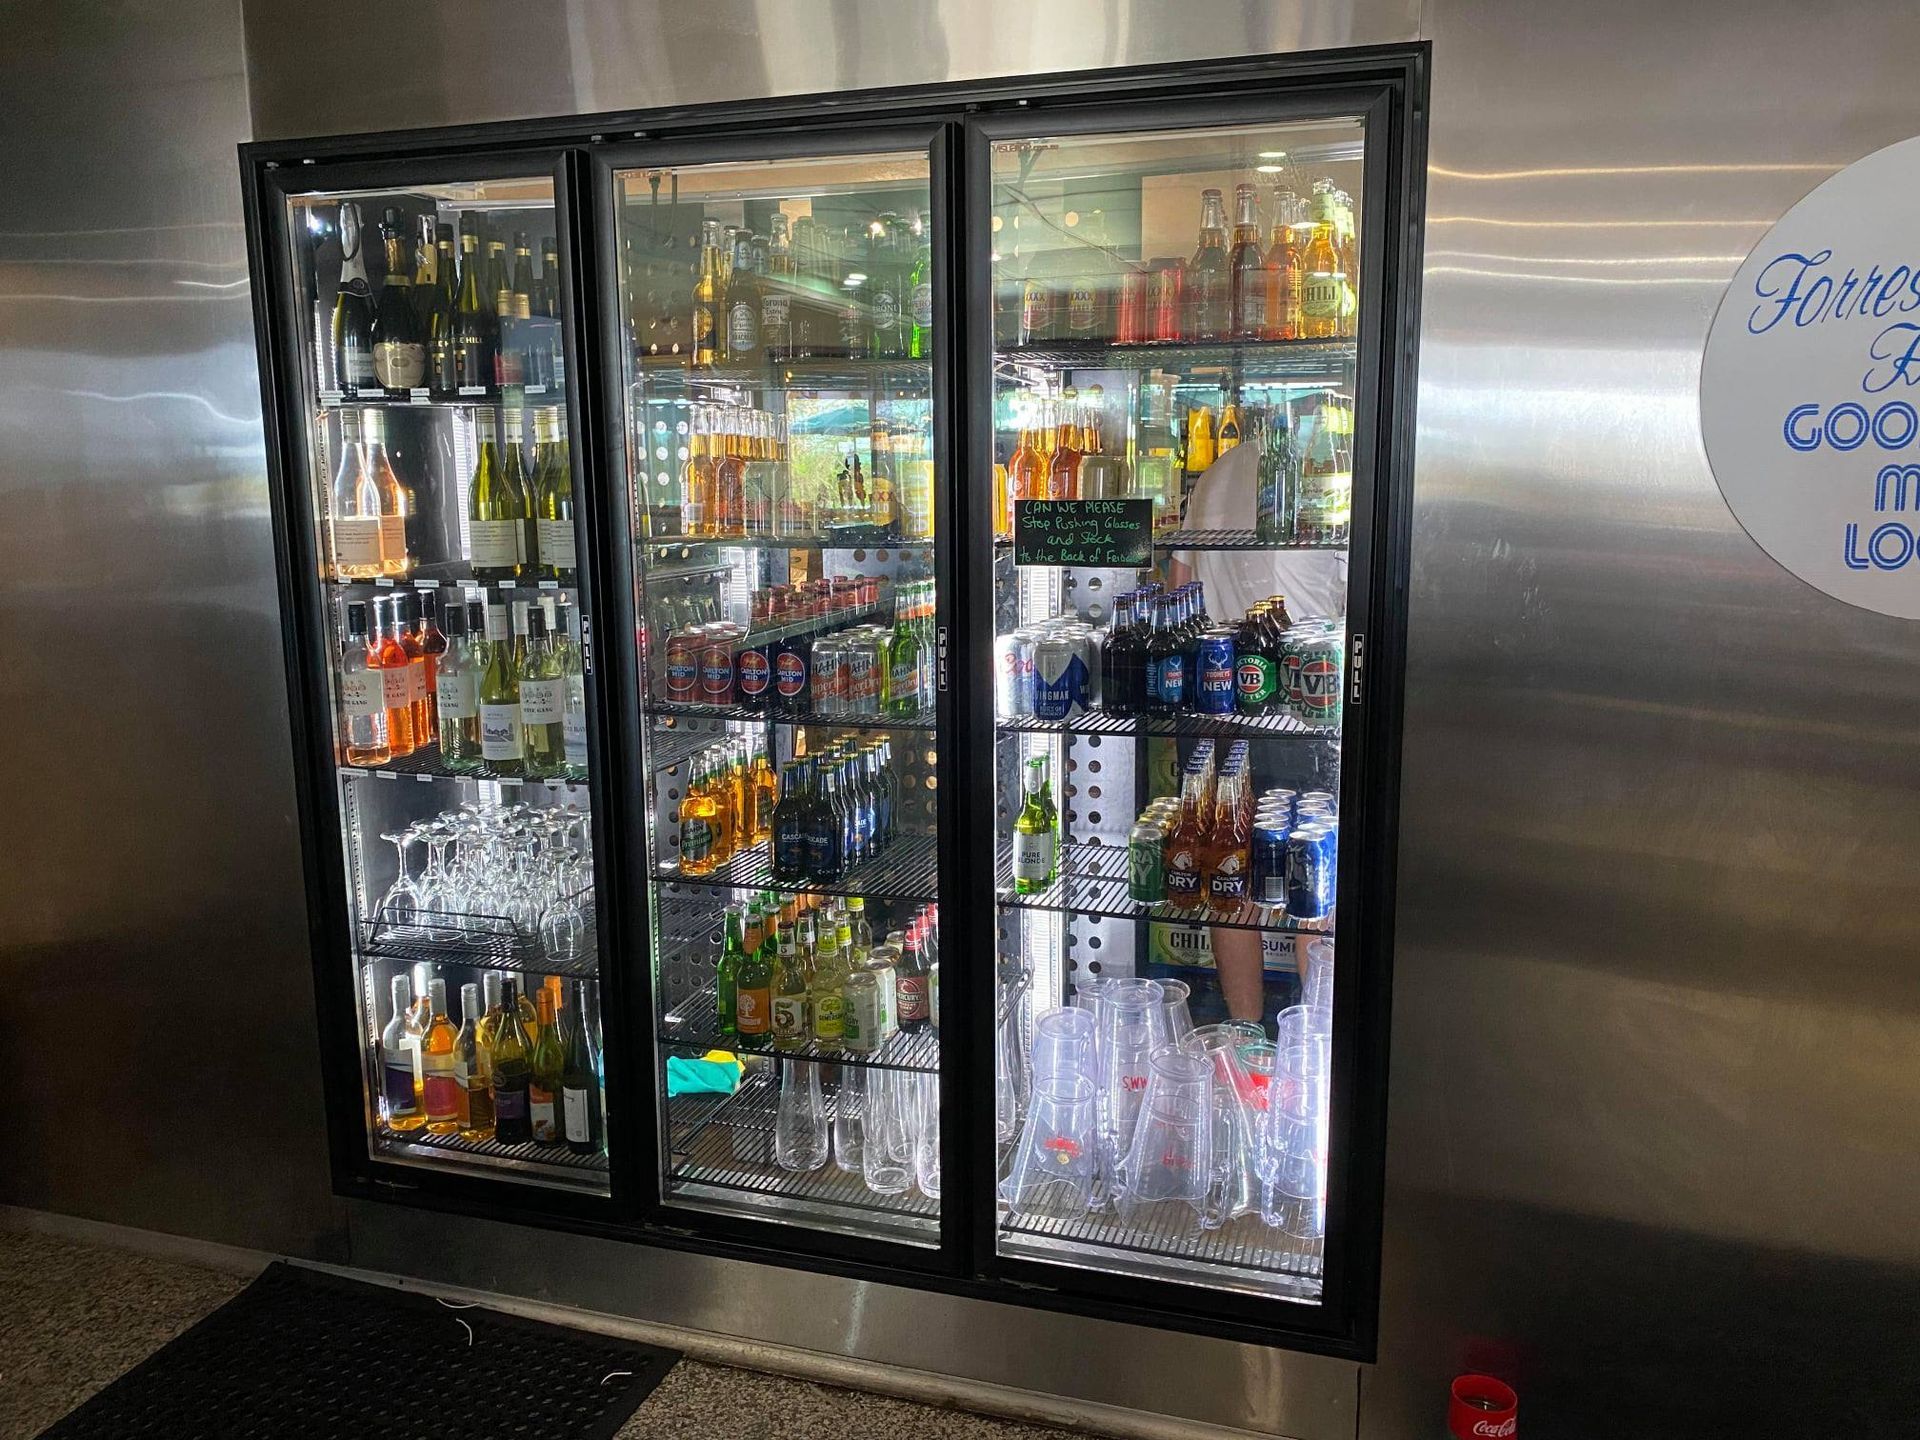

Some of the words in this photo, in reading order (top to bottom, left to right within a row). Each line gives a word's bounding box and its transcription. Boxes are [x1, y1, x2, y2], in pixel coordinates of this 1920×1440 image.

[1783, 401, 1920, 451] GOO
[1057, 502, 1078, 514] WE
[1022, 517, 1050, 531] Stop
[1056, 517, 1099, 537] Pushing
[1104, 517, 1141, 530] Glasses
[1047, 534, 1074, 546] and
[1844, 522, 1920, 571] LO
[1036, 547, 1056, 562] the
[1061, 549, 1085, 562] Back
[1089, 550, 1101, 562] of
[939, 633, 947, 686] PULL
[1353, 641, 1363, 698] PULL
[1203, 680, 1231, 691] NEW
[1240, 673, 1261, 685] VB
[1302, 674, 1337, 695] VB
[1168, 874, 1197, 888] DRY
[1212, 880, 1243, 892] DRY
[1170, 931, 1210, 950] CHIL
